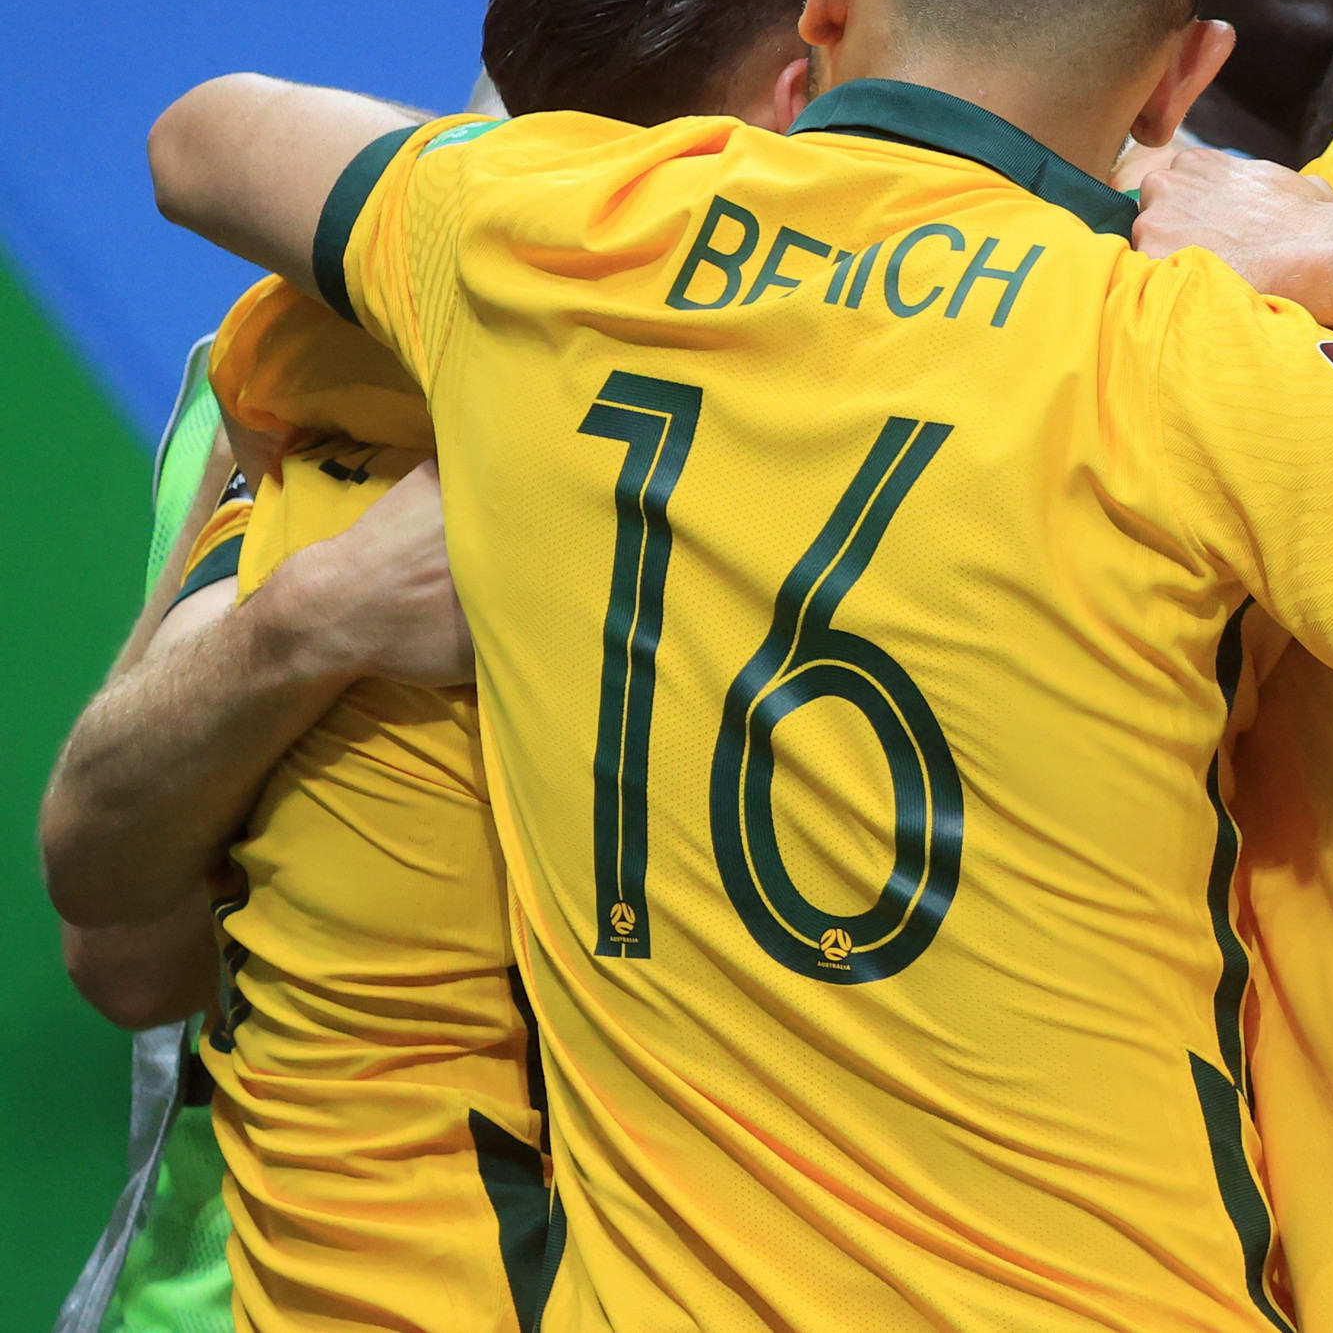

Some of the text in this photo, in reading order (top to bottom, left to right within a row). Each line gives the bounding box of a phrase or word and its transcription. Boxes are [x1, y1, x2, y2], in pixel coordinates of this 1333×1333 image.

[577, 369, 964, 985] 16
[609, 935, 639, 943] AUSTRALIA
[817, 960, 851, 971] AUSTRALIA
